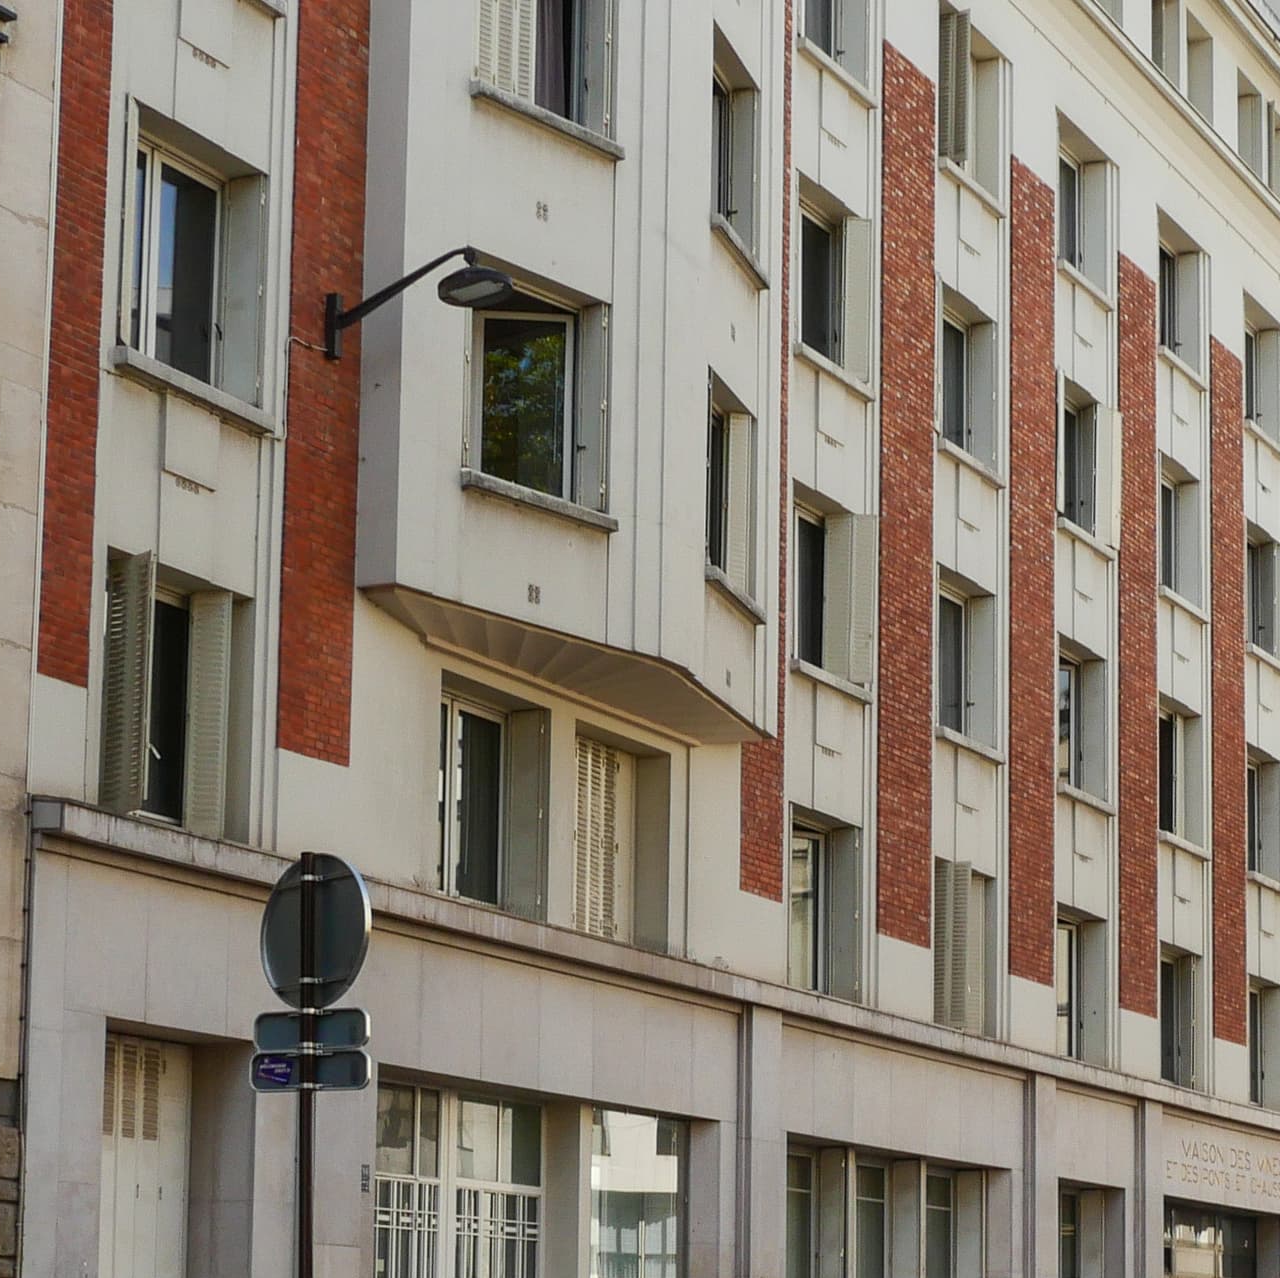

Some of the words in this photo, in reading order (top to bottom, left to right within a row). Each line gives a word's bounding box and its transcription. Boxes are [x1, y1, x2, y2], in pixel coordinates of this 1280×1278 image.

[1178, 1138, 1225, 1165] MAISON
[1229, 1147, 1251, 1171] DES
[1166, 1159, 1179, 1180] ET
[1181, 1163, 1199, 1184] DES
[1201, 1167, 1231, 1190] PONTS
[1236, 1173, 1247, 1192] ET
